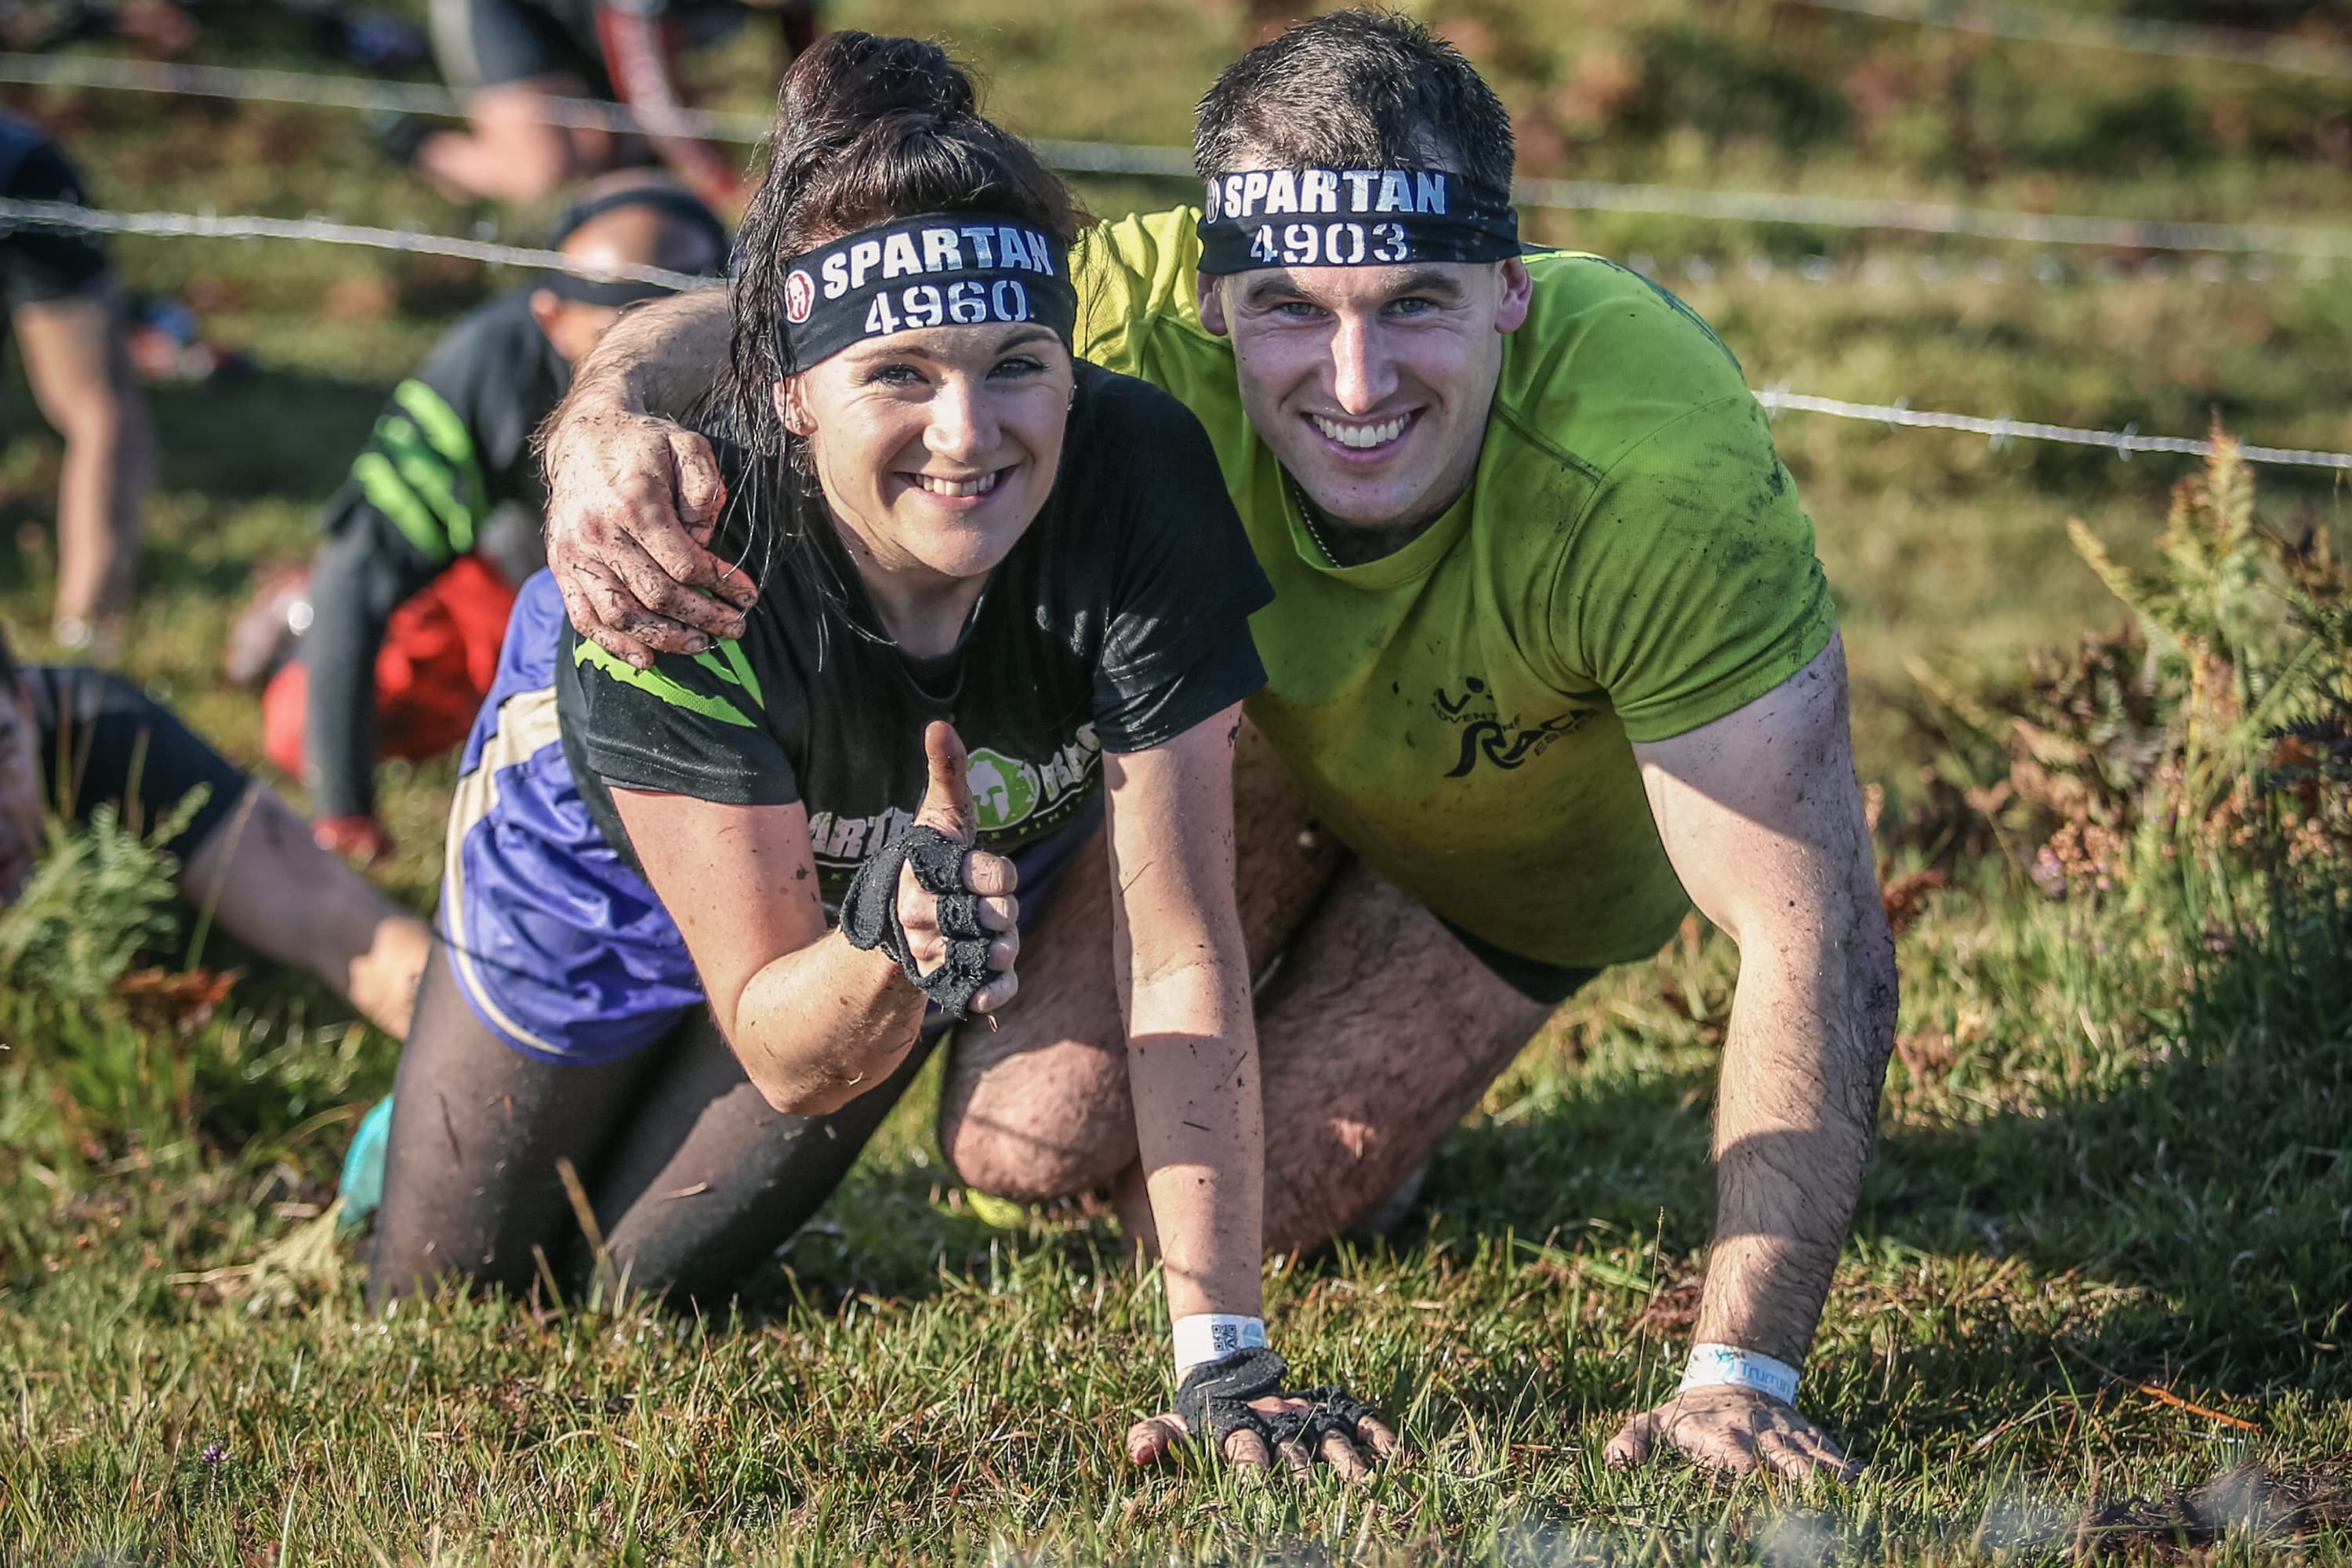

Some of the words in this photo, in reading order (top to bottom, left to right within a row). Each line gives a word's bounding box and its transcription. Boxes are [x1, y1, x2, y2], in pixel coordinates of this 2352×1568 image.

[1224, 169, 1446, 219] SPARTAN
[822, 227, 1054, 299] SPARTAN
[1250, 222, 1408, 264] 4903
[864, 280, 1029, 335] 4960
